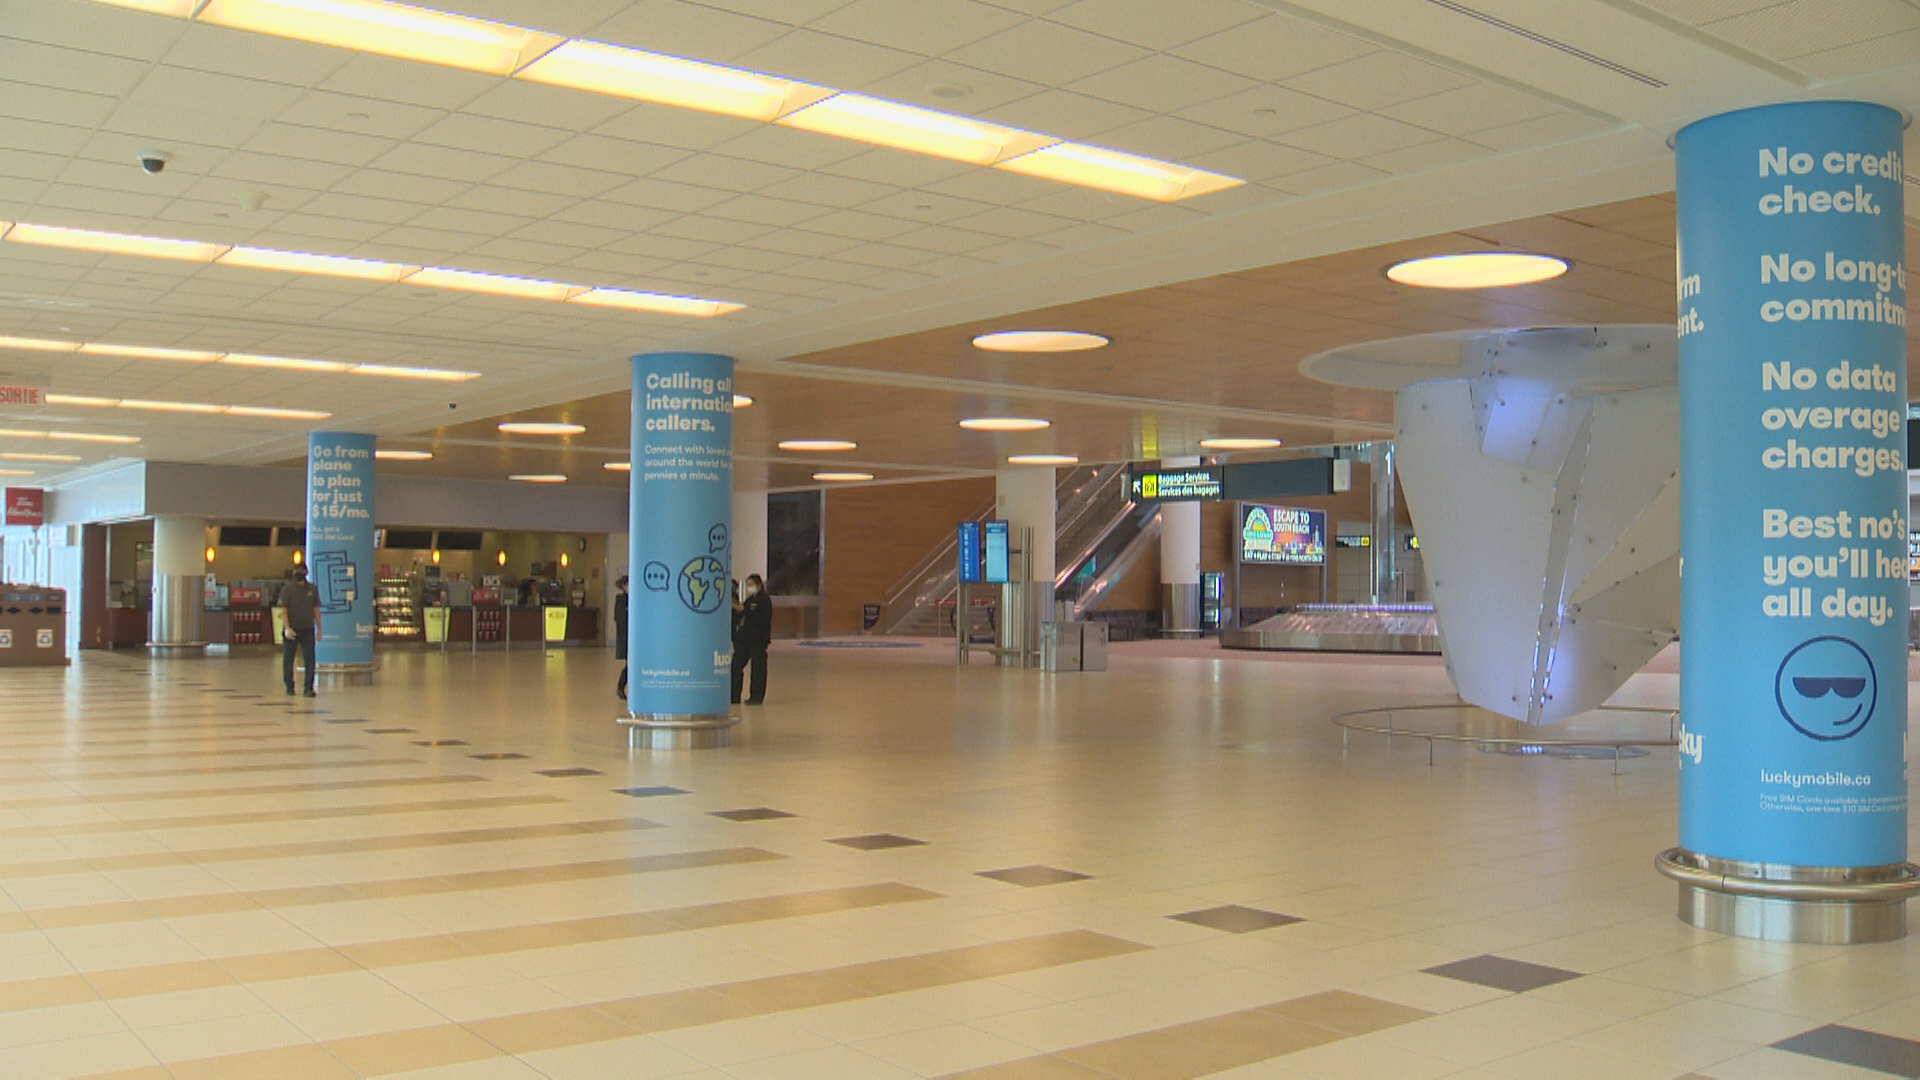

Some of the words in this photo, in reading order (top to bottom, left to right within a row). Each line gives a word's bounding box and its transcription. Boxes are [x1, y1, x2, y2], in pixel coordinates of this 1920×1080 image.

[1759, 147, 1814, 178] No
[1822, 151, 1903, 185] credit
[1759, 185, 1881, 216] check.
[1760, 253, 1816, 284] No
[646, 372, 713, 394] Calling
[717, 378, 731, 392] all
[1762, 361, 1817, 391] No
[1825, 360, 1896, 392] data
[645, 414, 715, 432] callers.
[1761, 407, 1901, 439] overage
[313, 445, 332, 458] Go
[335, 445, 369, 459] from
[645, 444, 683, 455] Connect
[685, 444, 705, 455] with
[1761, 439, 1904, 476] charges.
[313, 459, 352, 473] plane
[645, 457, 676, 467] around
[678, 457, 694, 467] the
[696, 459, 719, 468] world
[313, 475, 325, 486] to
[327, 474, 361, 489] plan
[645, 470, 678, 481] pennies
[680, 472, 687, 480] a
[689, 470, 720, 480] minute.
[1158, 473, 1185, 485] Baggage
[1185, 471, 1210, 483] Services
[313, 490, 331, 502] for
[333, 489, 362, 505] just
[1158, 485, 1182, 497] Services
[1182, 484, 1193, 496] des
[1193, 484, 1220, 497] bagages
[312, 503, 370, 519] $15/mo.
[1274, 509, 1299, 523] ESCAPE
[1300, 511, 1310, 524] TO
[1273, 523, 1292, 533] SOUTH
[1293, 524, 1310, 534] BEACH
[1763, 509, 1852, 539] Best
[1860, 509, 1906, 540] no's
[1763, 549, 1868, 586] you'll
[1762, 587, 1812, 617] all
[1821, 587, 1894, 626] day.
[1760, 769, 1871, 788] luckymobile.ca
[1760, 793, 1777, 802] Free
[1780, 794, 1795, 803] SIM
[1797, 795, 1823, 804] Cards
[1760, 801, 1804, 813] Otherwise,
